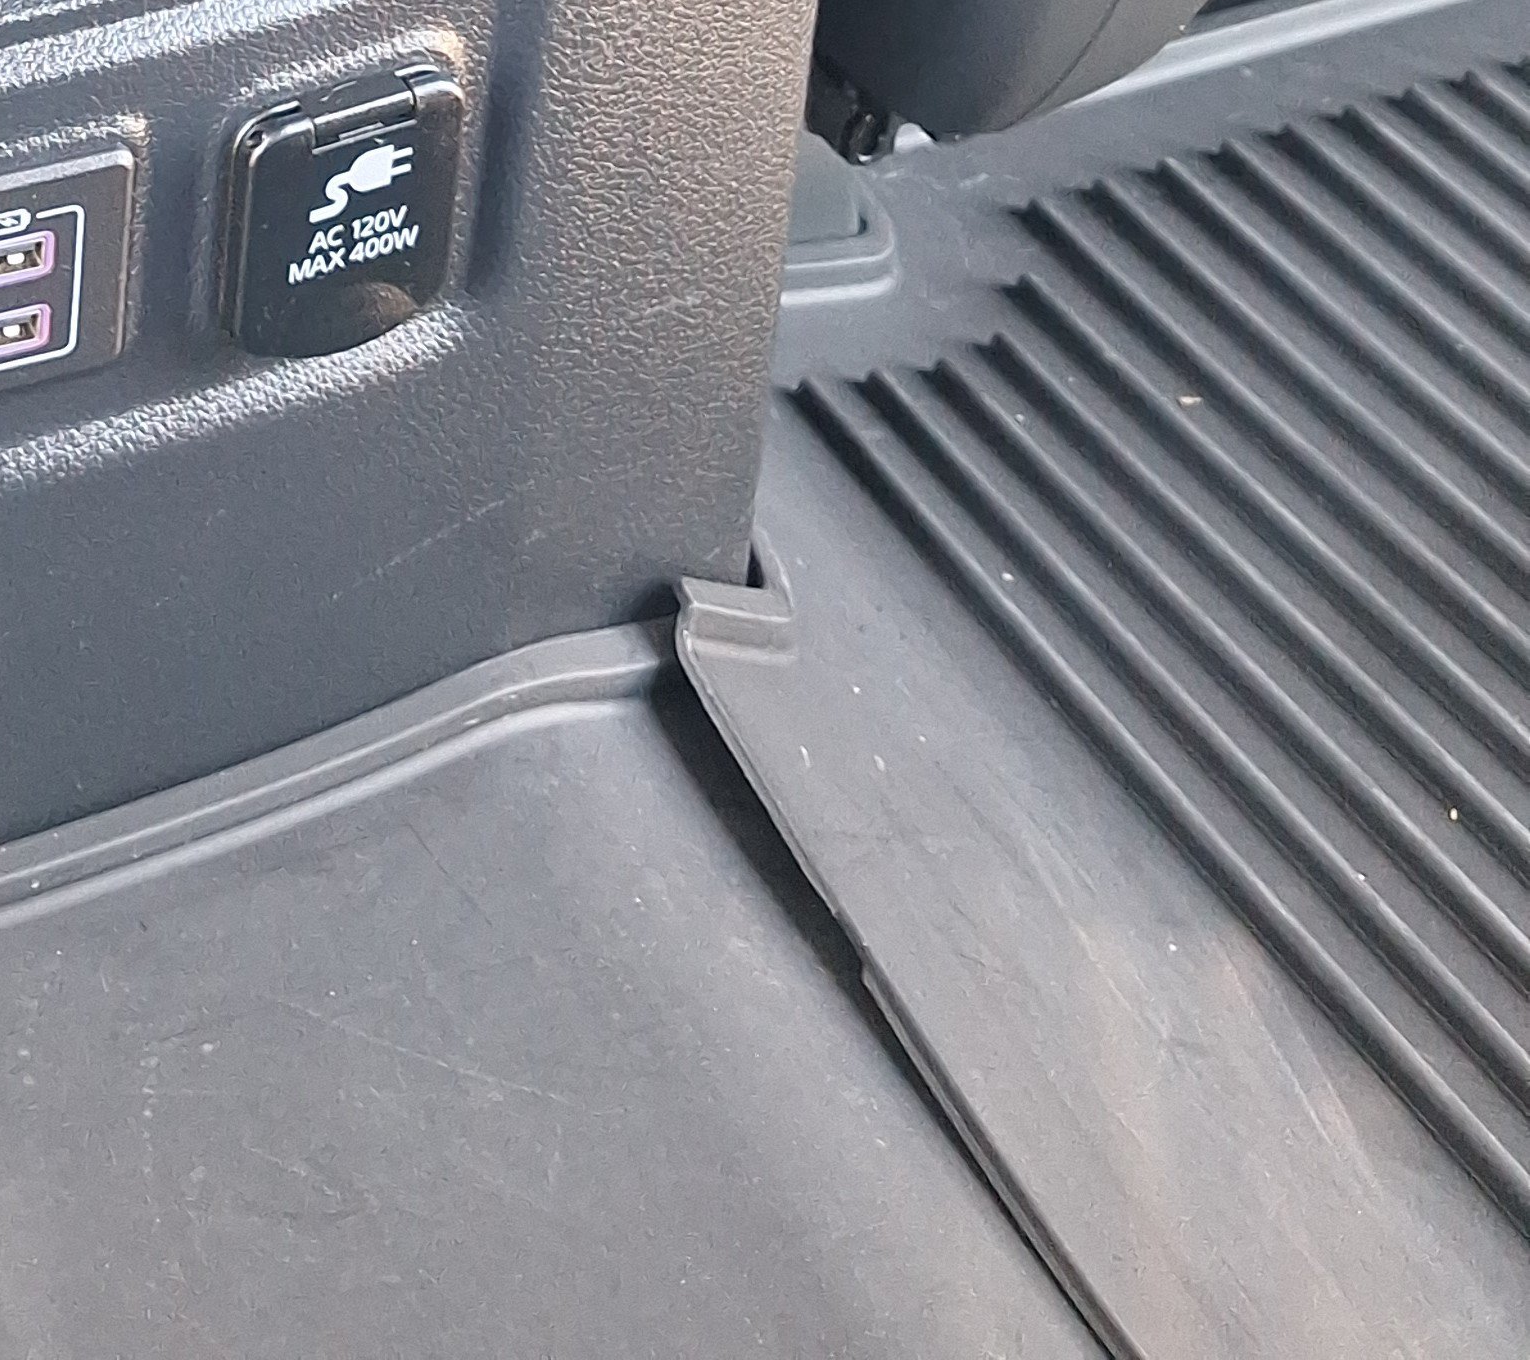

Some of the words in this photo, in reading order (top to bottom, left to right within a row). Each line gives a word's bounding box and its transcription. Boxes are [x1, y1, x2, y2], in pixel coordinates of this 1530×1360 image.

[287, 247, 347, 285] MAX
[349, 224, 420, 263] 400W
[308, 223, 344, 253] AC
[352, 205, 408, 241] 120V
